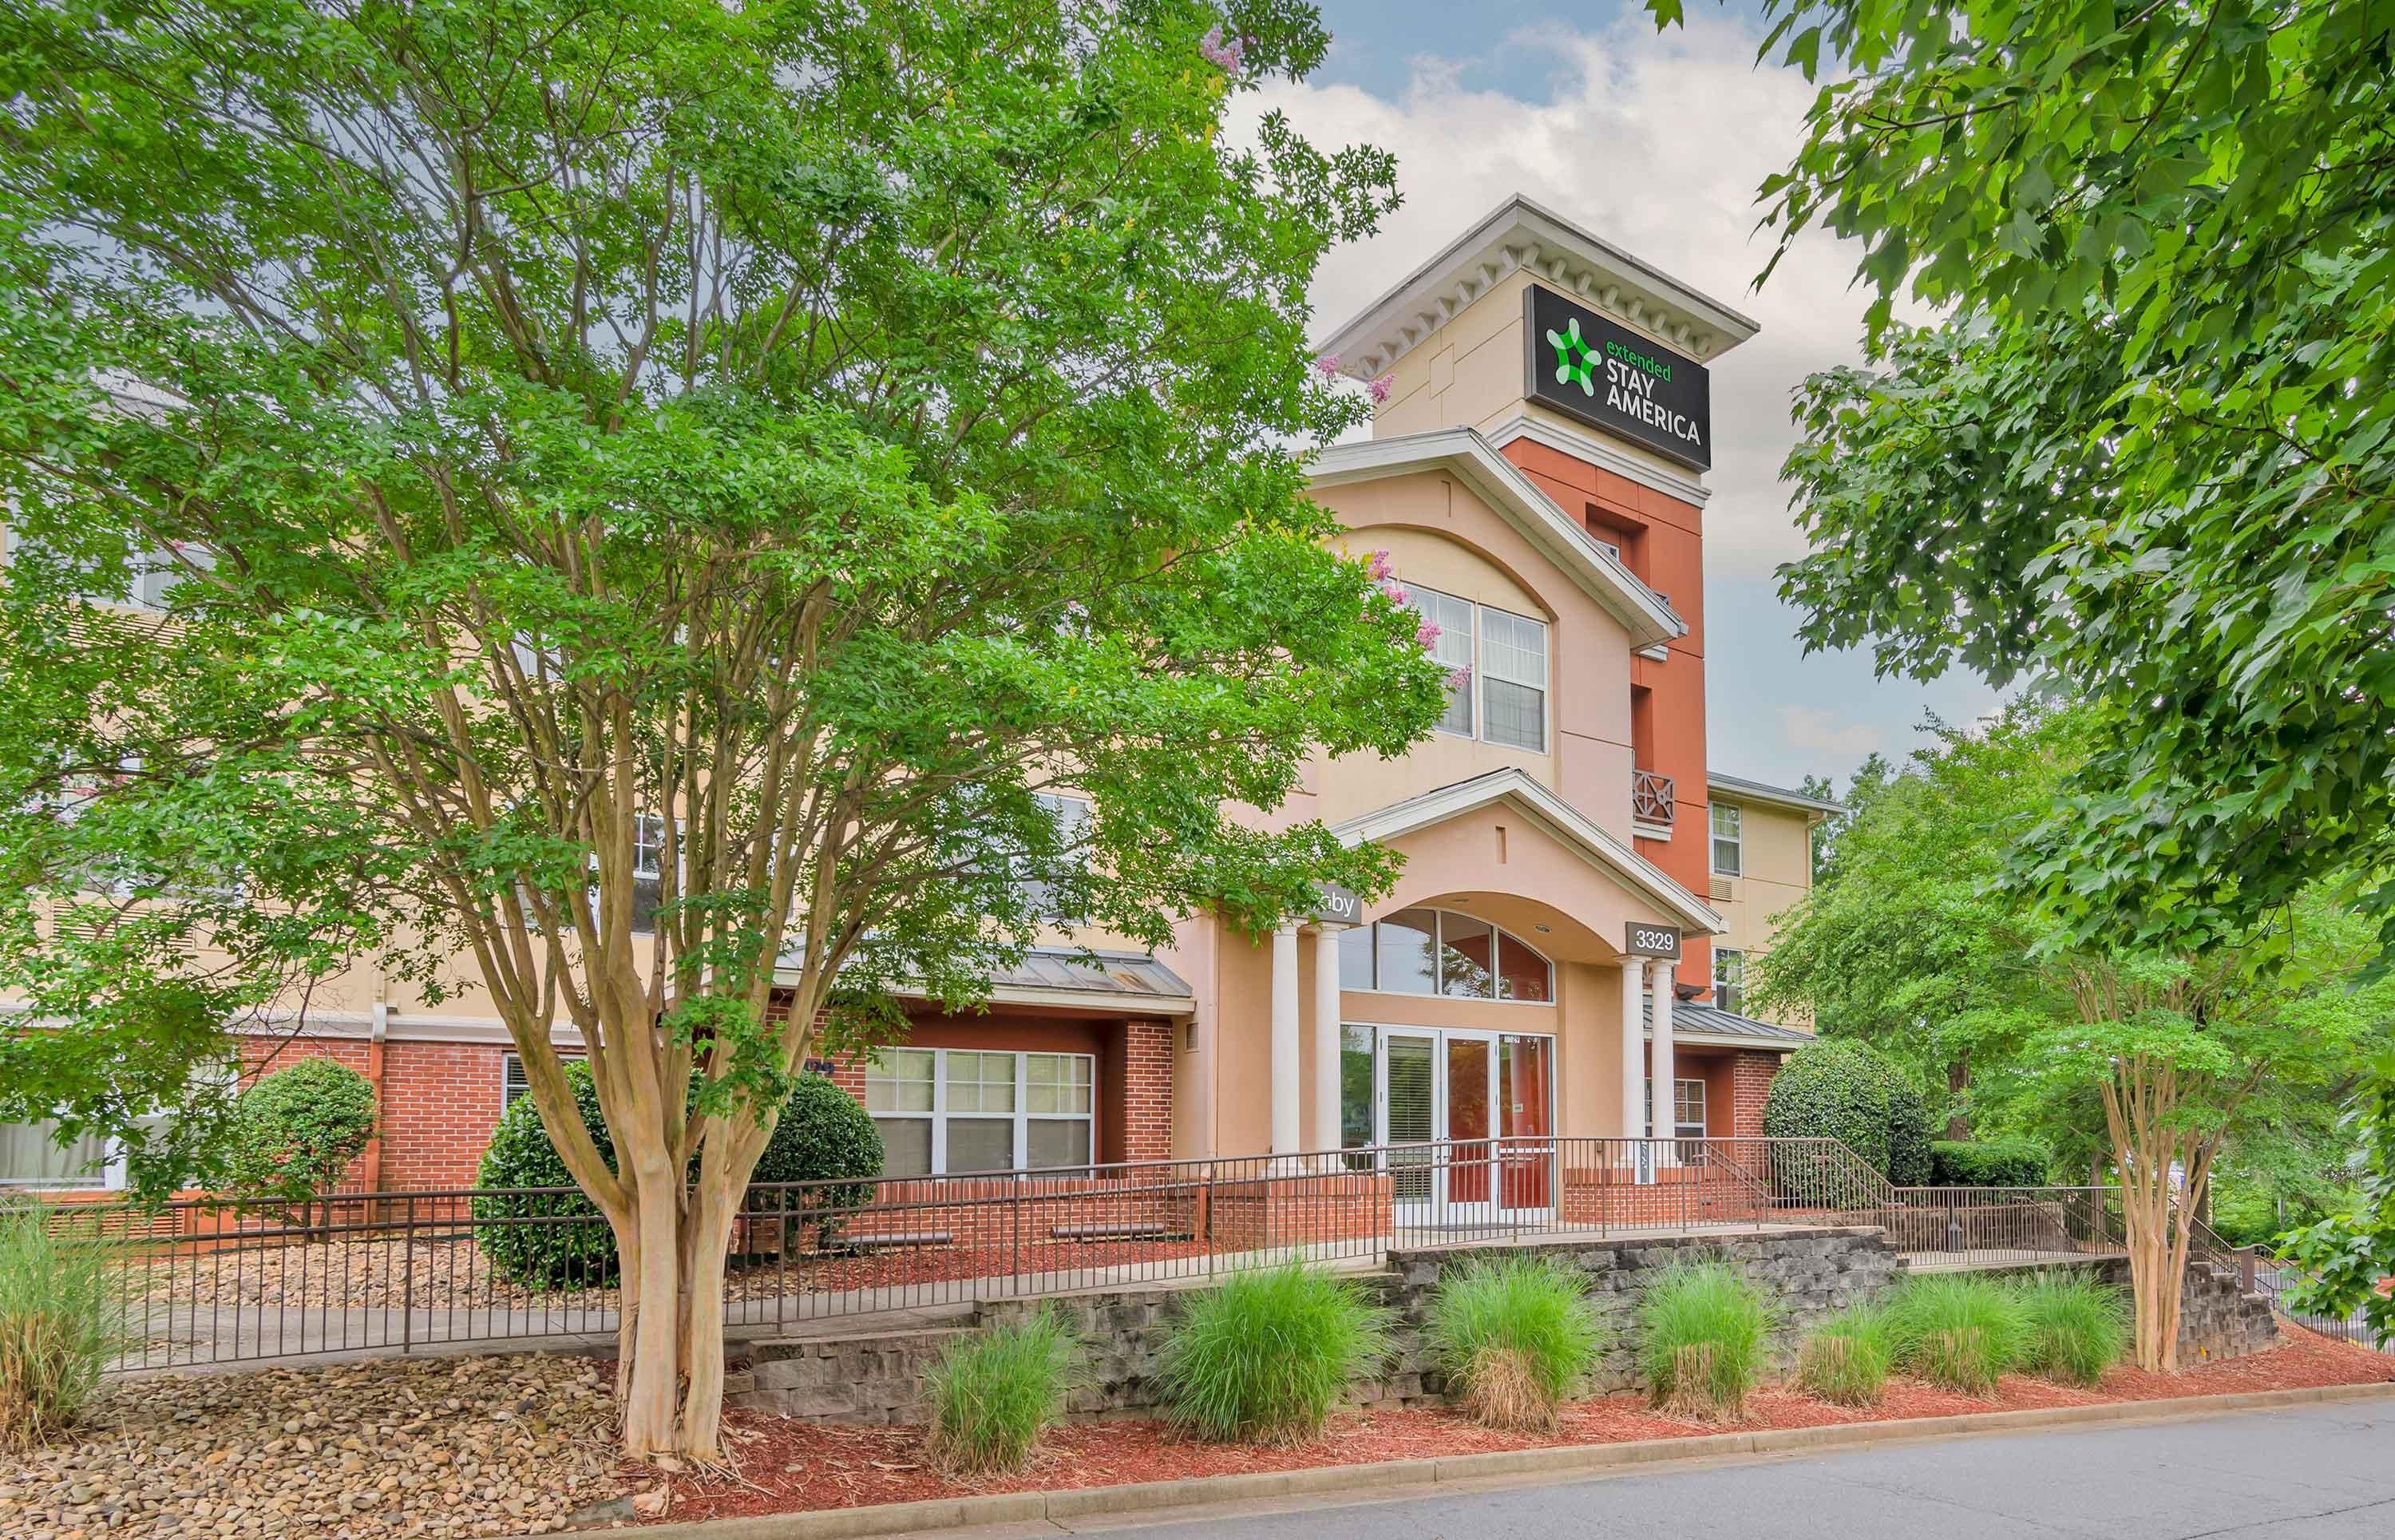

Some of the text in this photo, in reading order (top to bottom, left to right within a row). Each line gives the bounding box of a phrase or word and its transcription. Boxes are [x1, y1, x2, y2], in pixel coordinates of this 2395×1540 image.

[1606, 339, 1672, 382] extended
[1606, 358, 1655, 398] STAY
[1606, 385, 1700, 445] AMERICA
[1636, 930, 1674, 950] 3329
